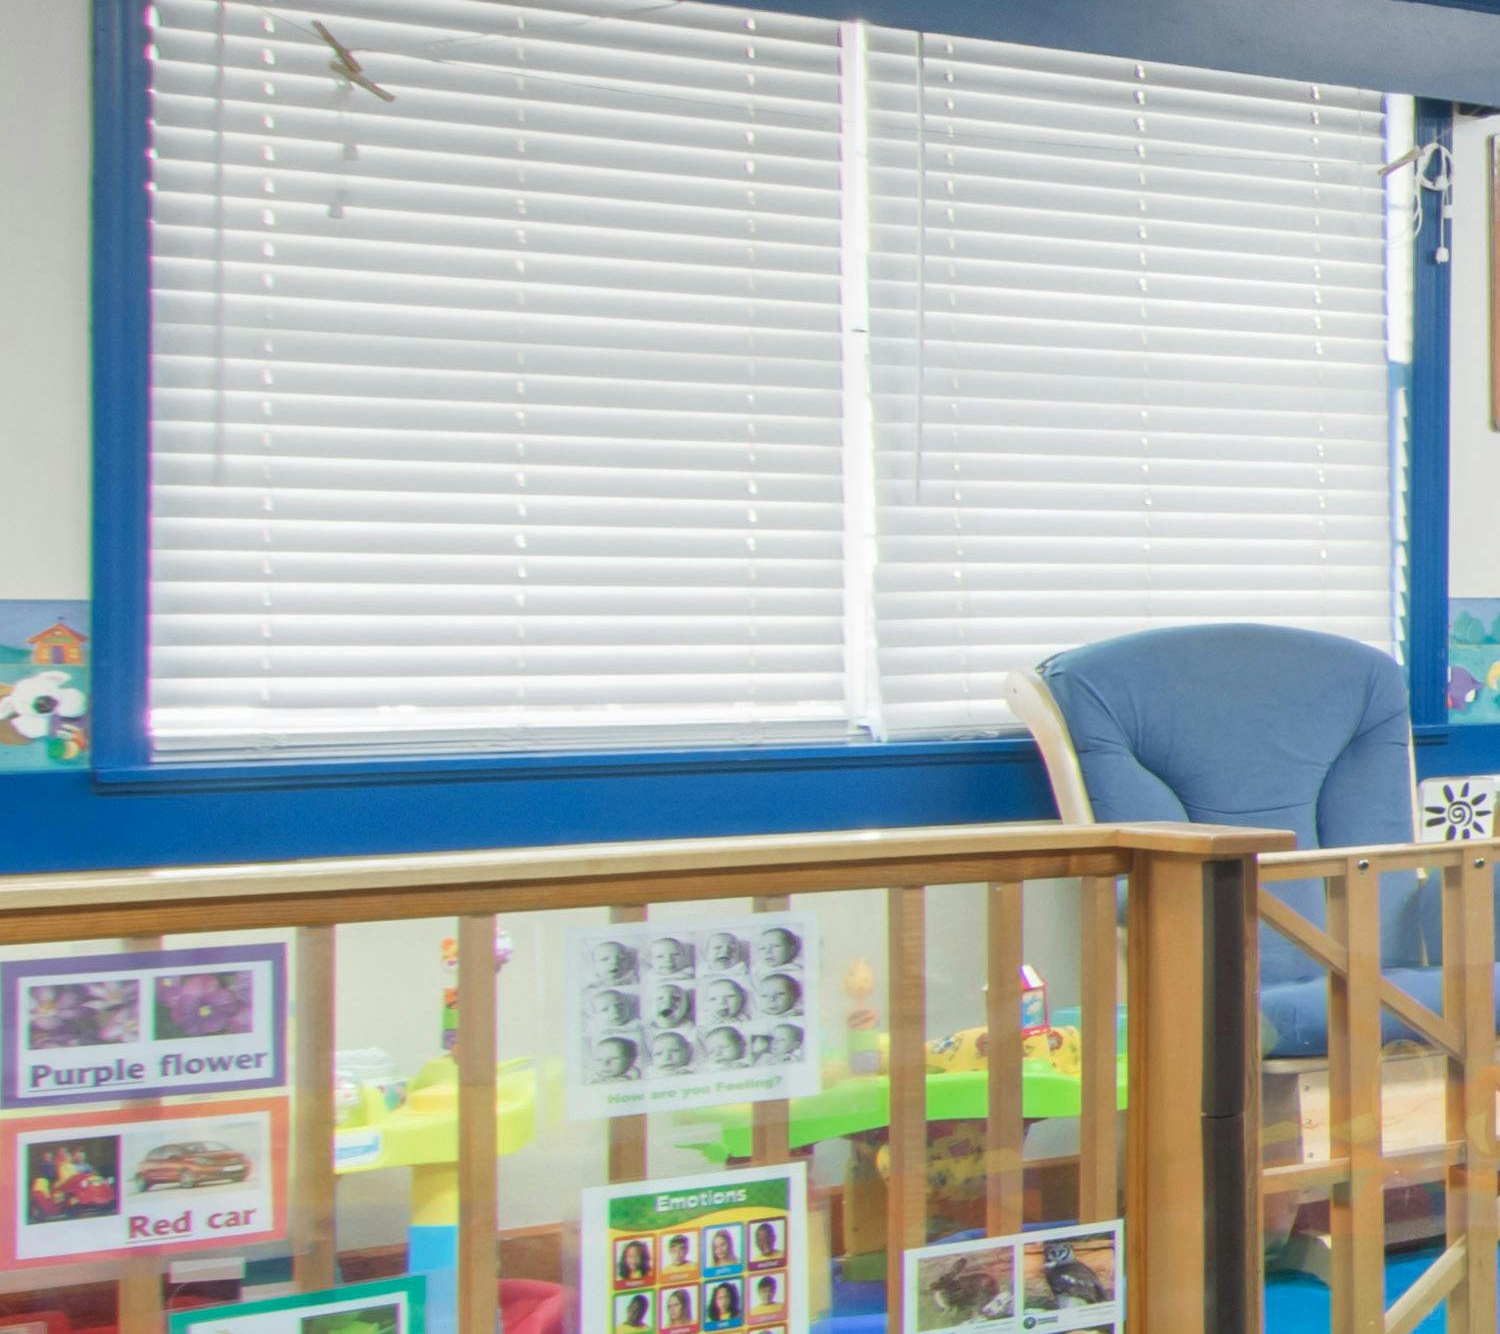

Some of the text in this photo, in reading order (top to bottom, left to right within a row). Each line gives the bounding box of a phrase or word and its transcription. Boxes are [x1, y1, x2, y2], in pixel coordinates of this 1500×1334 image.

[30, 1052, 268, 1088] Purple flower
[608, 1075, 783, 1104] How are you Feeling?
[655, 1187, 748, 1213] Emotions
[127, 1208, 258, 1239] Red car
